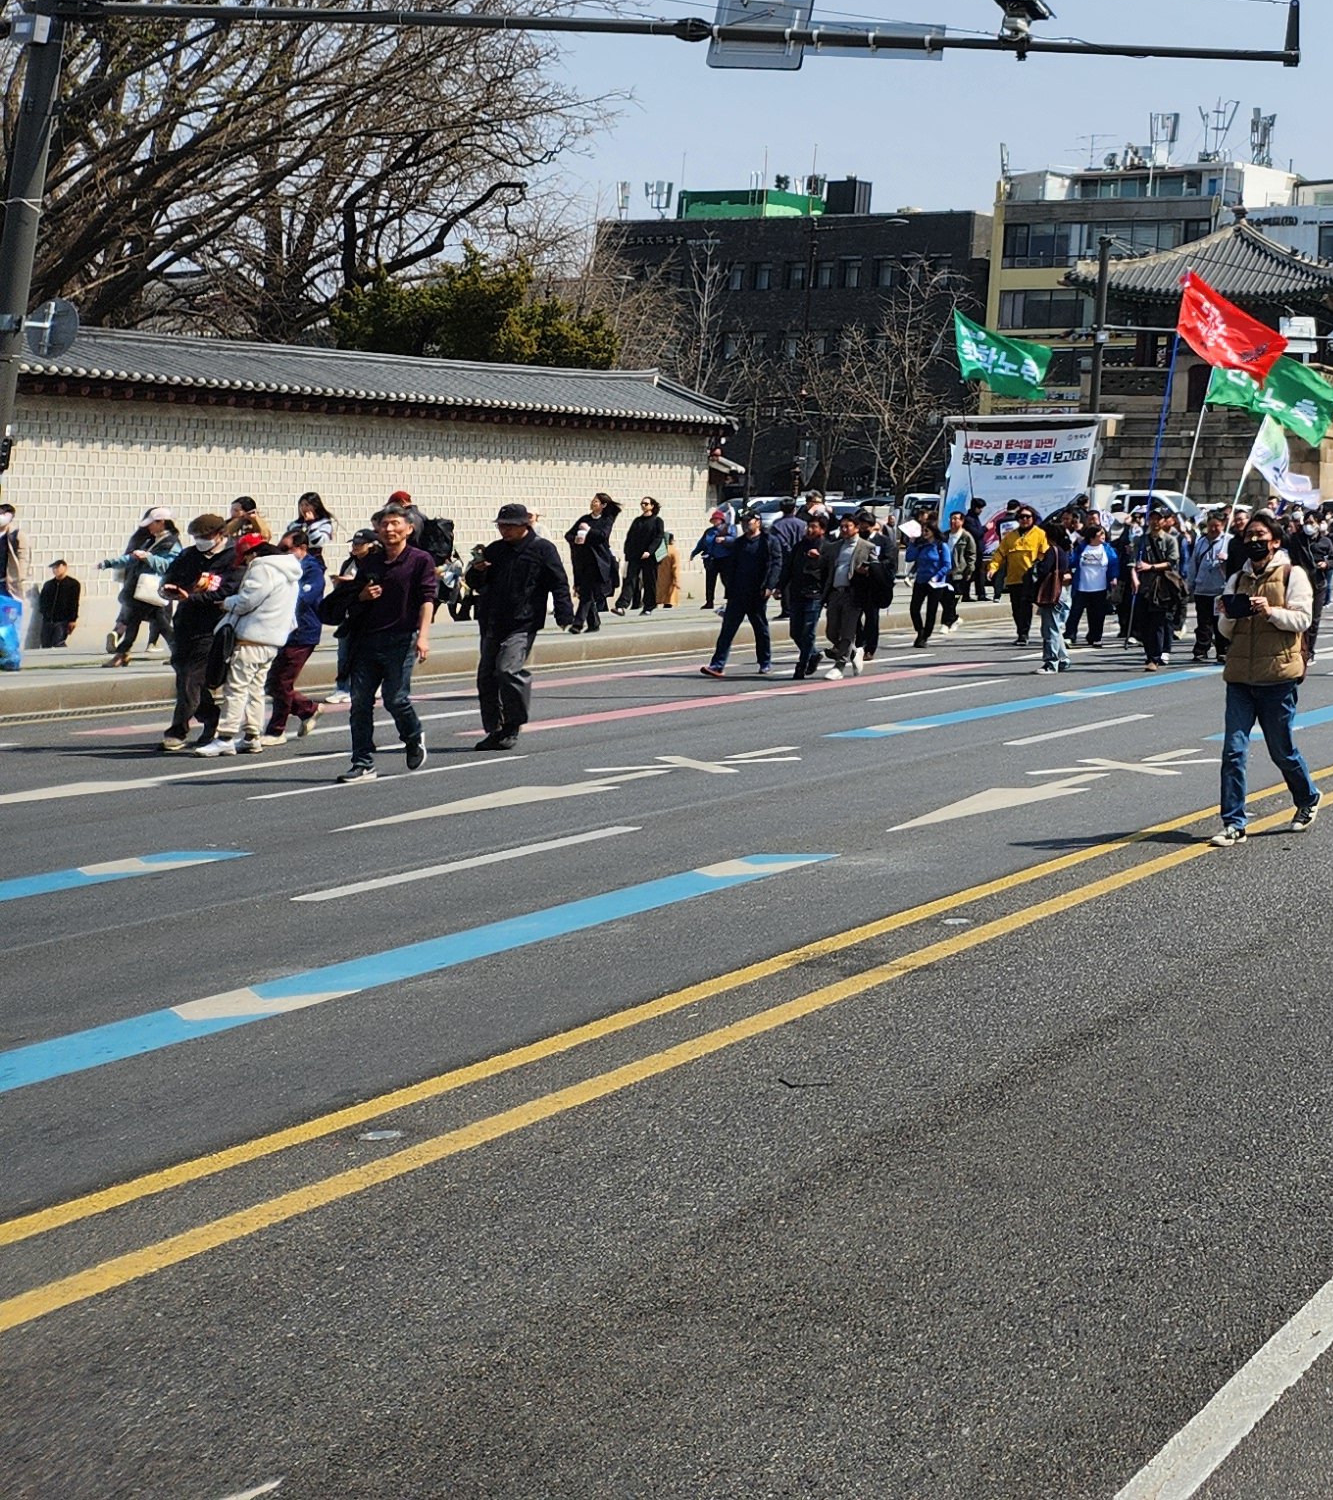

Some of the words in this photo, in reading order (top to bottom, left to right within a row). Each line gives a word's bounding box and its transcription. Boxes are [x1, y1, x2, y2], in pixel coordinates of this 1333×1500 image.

[1005, 438, 1033, 449] 윤석열
[1035, 438, 1057, 449] 파면!
[962, 451, 1004, 466] 한국노총
[1006, 451, 1029, 466] 투쟁
[1029, 451, 1052, 465] 승리
